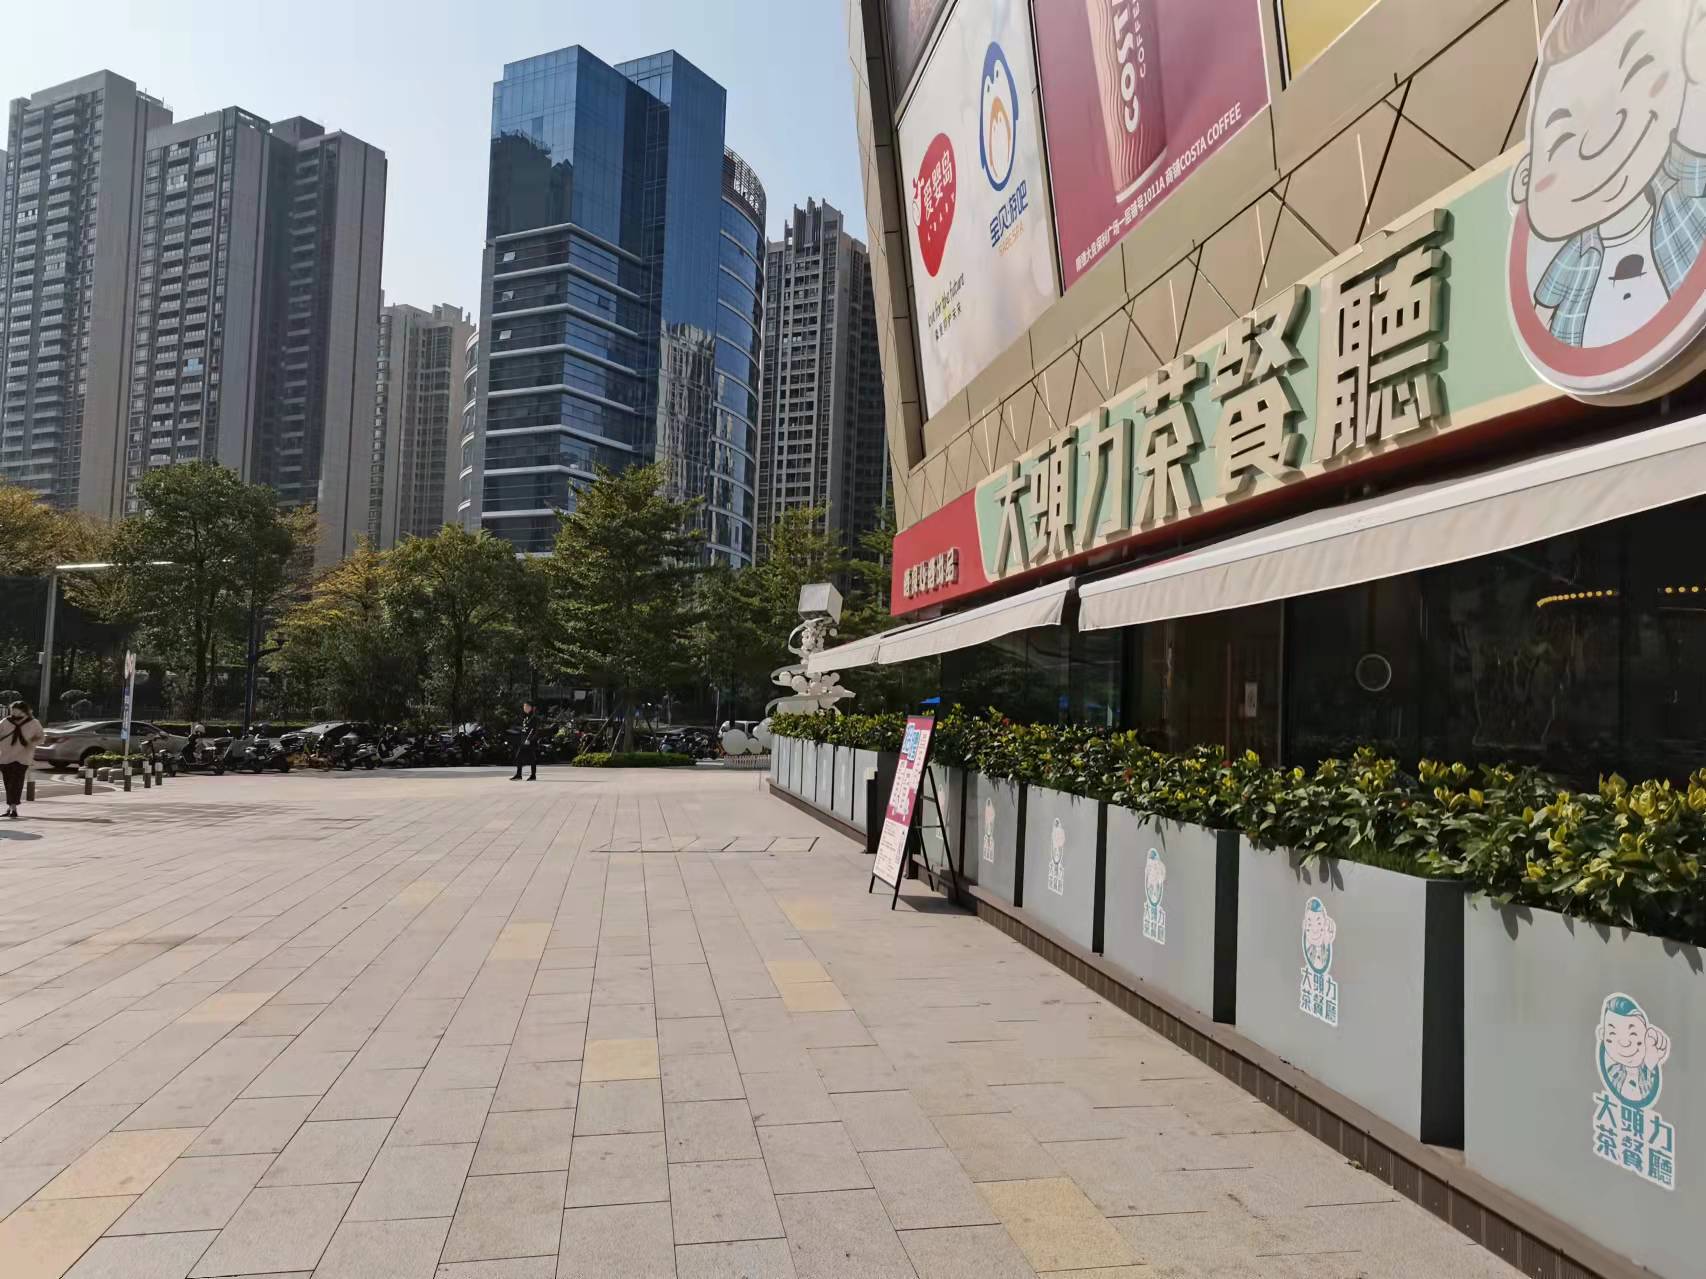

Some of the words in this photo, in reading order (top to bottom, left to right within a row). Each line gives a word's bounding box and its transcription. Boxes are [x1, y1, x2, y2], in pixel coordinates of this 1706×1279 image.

[1112, 0, 1139, 133] COST
[1132, 0, 1146, 78] COFFE
[1207, 102, 1242, 146] COFFEE
[923, 149, 953, 221] 爱婴岛
[993, 208, 1452, 574] 大頭力茶餐廳
[1301, 988, 1337, 1023] 茶餐廳
[1302, 968, 1337, 1000] 大頭力
[1595, 1094, 1673, 1153] 大頭力
[1595, 1123, 1673, 1186] 茶餐廳
